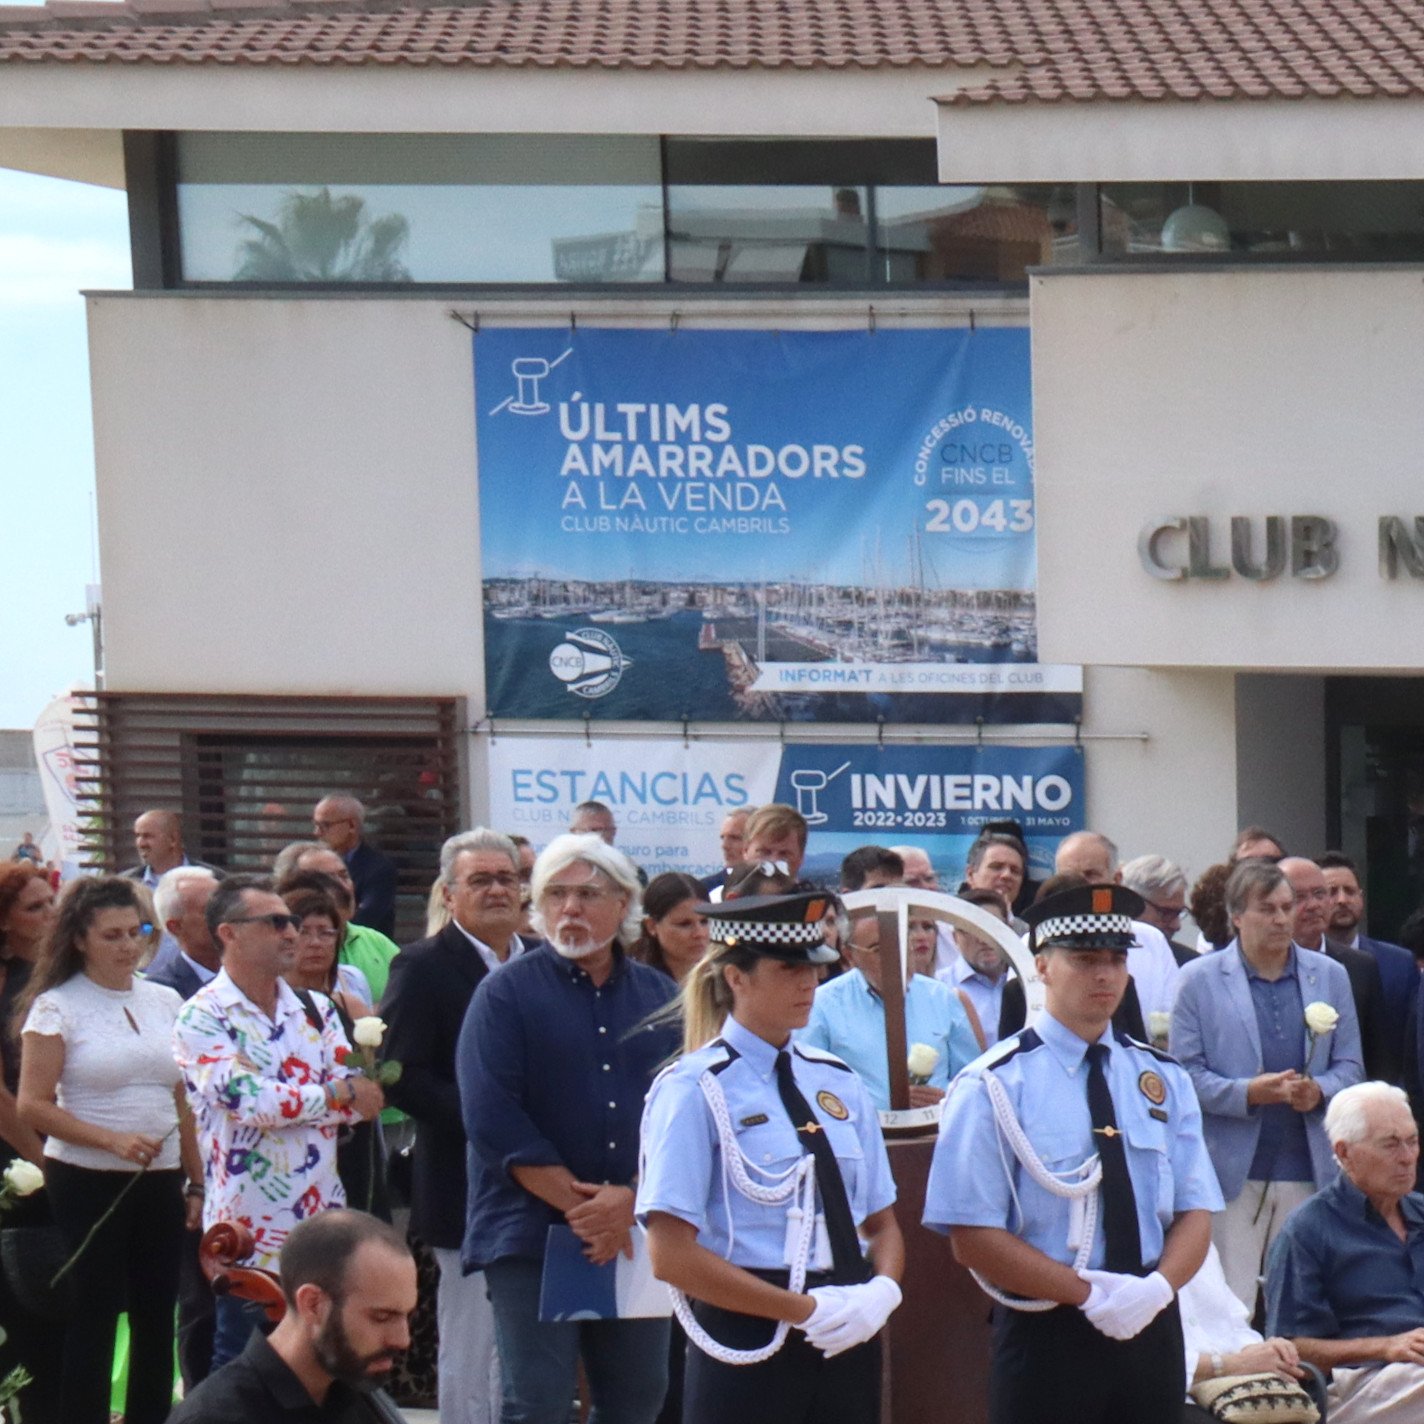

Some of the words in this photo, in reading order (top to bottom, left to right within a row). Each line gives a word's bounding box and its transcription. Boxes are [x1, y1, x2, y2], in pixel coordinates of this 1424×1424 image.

[559, 391, 732, 442] ÚLTIMS
[913, 404, 977, 486] CONCESSIÓ
[940, 442, 1014, 464] CNCB
[560, 443, 867, 479] AMARRADORS
[941, 467, 987, 485] FINS
[992, 467, 1016, 485] EL
[561, 481, 587, 510] A
[599, 481, 647, 510] LA
[657, 481, 787, 511] VENDA
[561, 516, 612, 532] CLUB
[616, 513, 689, 534] NÀUTIC
[694, 517, 791, 534] CAMBRILS
[924, 498, 1035, 533] 2043
[1137, 515, 1341, 581] CLUB
[779, 669, 873, 683] INFORMA'T
[878, 672, 887, 683] A
[891, 672, 914, 683] LES
[918, 672, 976, 684] OFICINES
[980, 672, 1004, 684] DEL
[1008, 672, 1044, 684] CLUB
[511, 769, 749, 806] ESTANCIAS
[851, 774, 1073, 811] INVIERNO
[512, 807, 551, 822] CLUB
[627, 809, 715, 826] CAMBRILS
[1026, 816, 1035, 826] 31
[1038, 817, 1070, 826] MAYO
[655, 845, 689, 857] para
[884, 1114, 898, 1125] 12
[923, 1109, 935, 1120] 11
